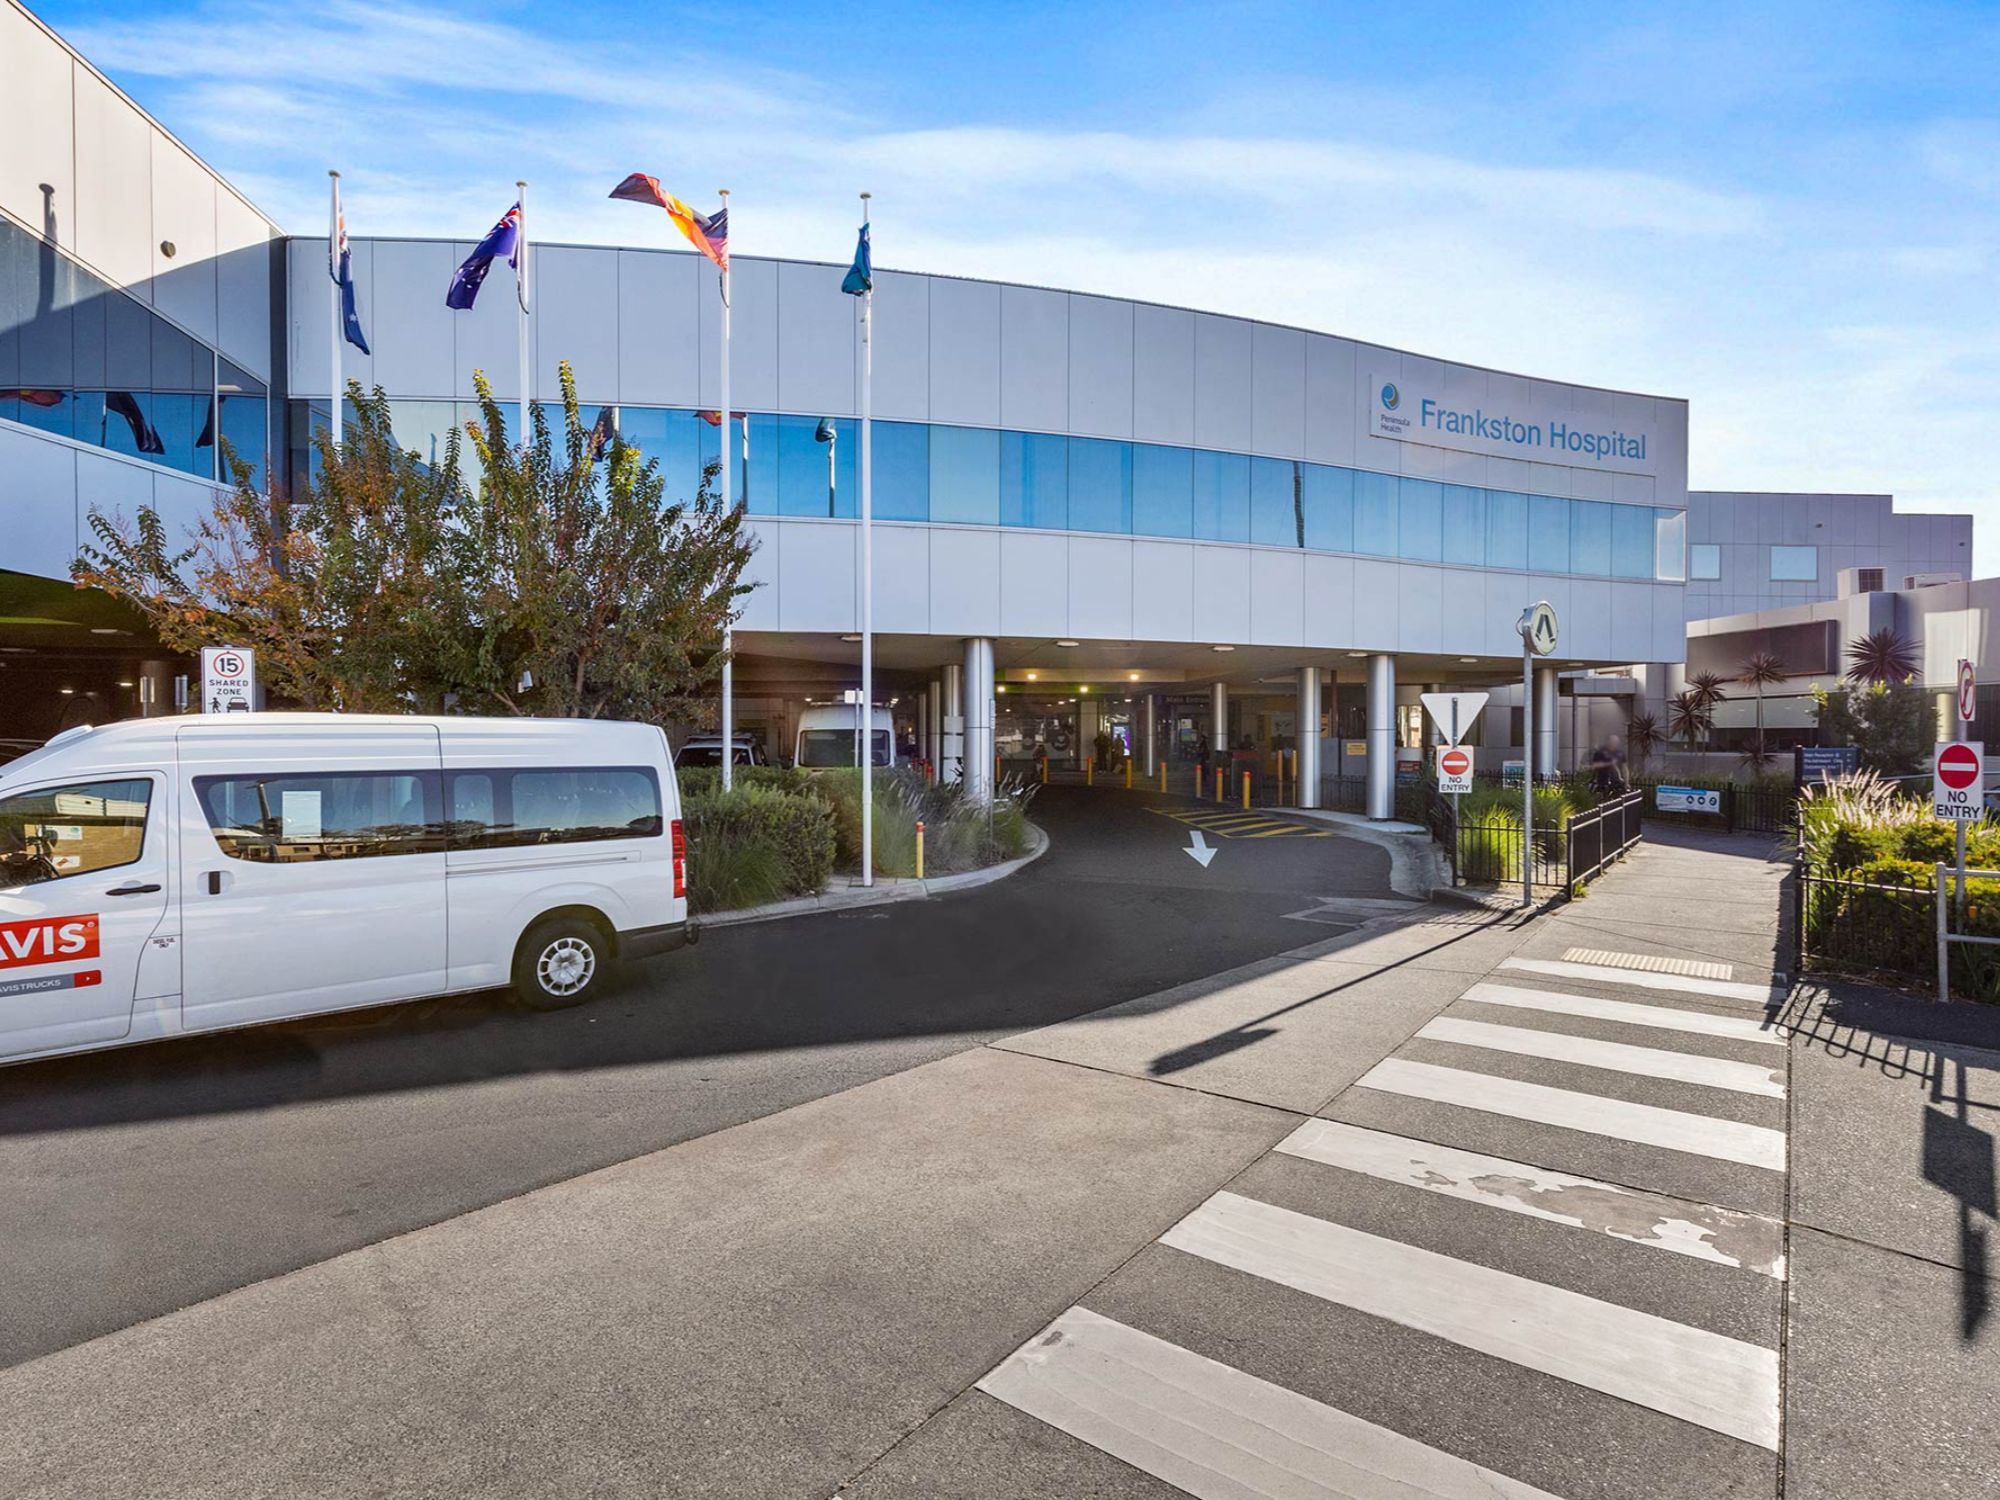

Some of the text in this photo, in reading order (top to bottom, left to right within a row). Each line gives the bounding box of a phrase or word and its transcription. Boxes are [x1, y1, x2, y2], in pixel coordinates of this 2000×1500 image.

[1421, 398, 1646, 460] Frankston Hospital
[219, 657, 239, 672] 15
[209, 679, 249, 687] SHARED
[1948, 791, 1968, 803] NO
[1936, 804, 1981, 818] ENTRY
[0, 923, 87, 961] VIS
